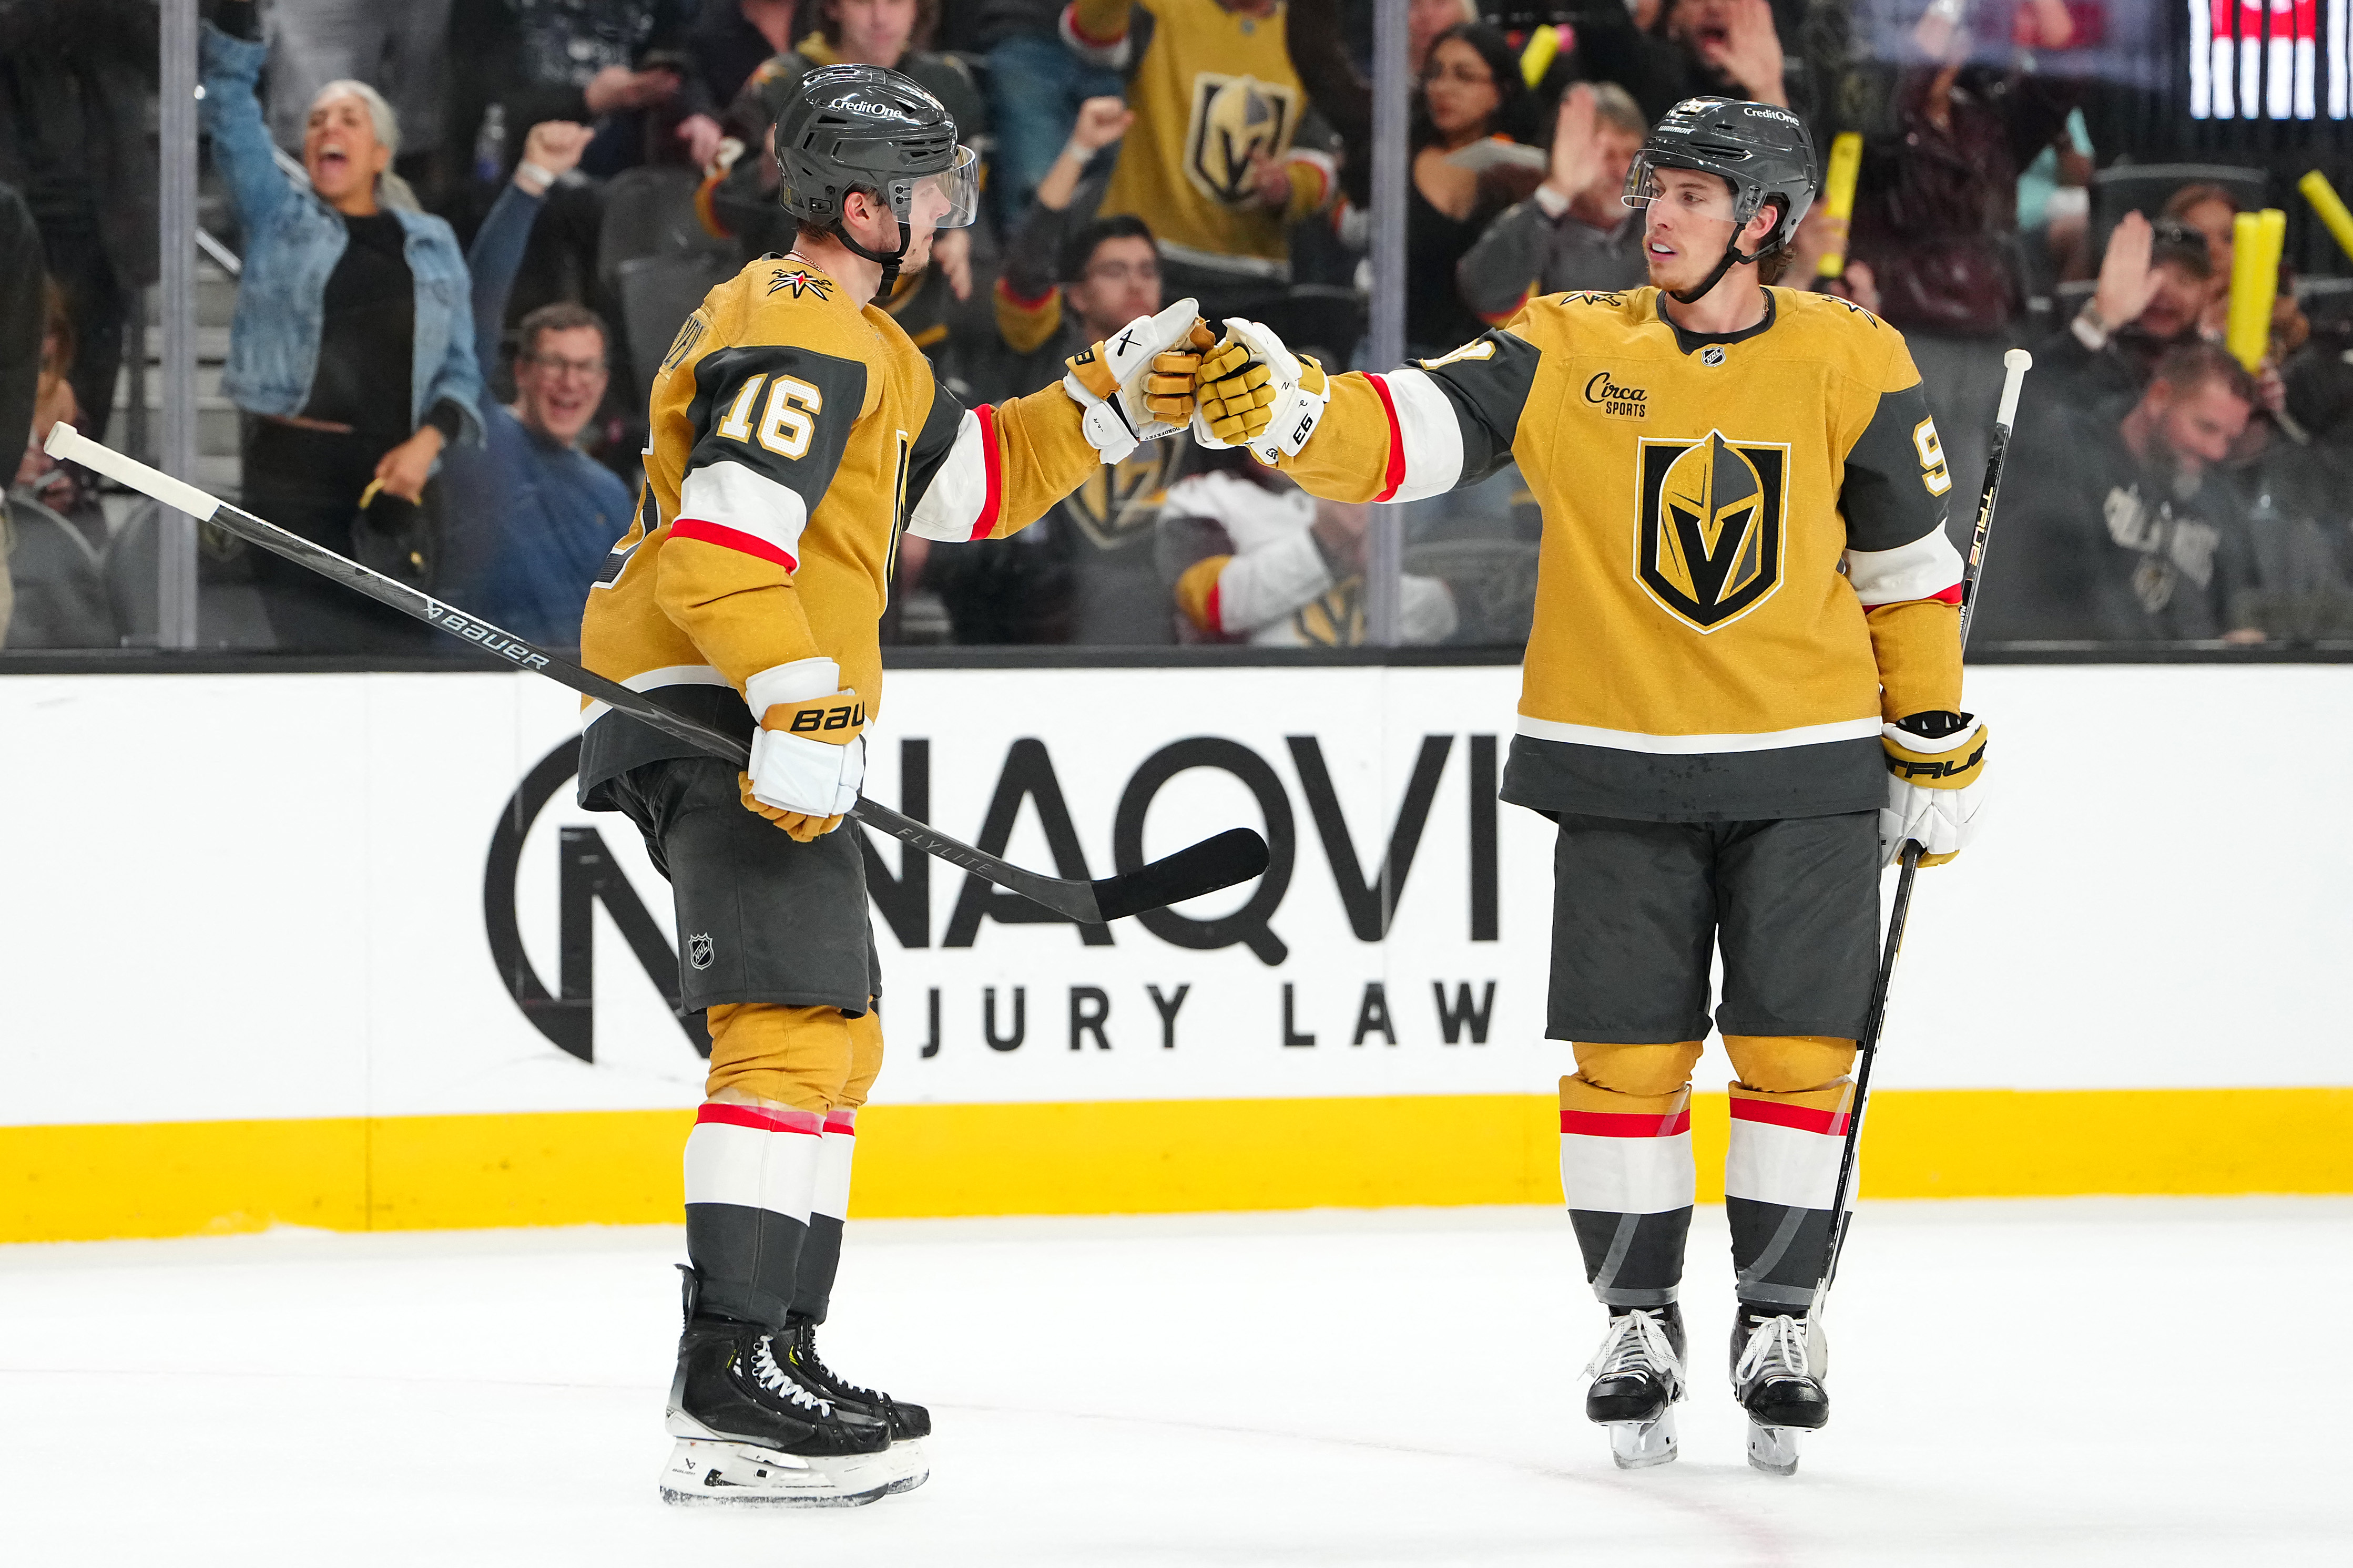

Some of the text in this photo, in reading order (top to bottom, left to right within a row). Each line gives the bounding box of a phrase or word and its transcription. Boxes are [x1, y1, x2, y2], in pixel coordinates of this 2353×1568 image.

[831, 98, 902, 118] CreditOne
[1744, 108, 1799, 126] CreditOne
[1585, 372, 1647, 403] Circa
[716, 373, 823, 461] 16
[1606, 401, 1645, 417] SPORTS
[1145, 427, 1181, 440] DOROFEYEV
[1968, 486, 1994, 566] TRUE
[895, 827, 993, 873] FLYLITE
[921, 981, 1496, 1058] JURY LAW
